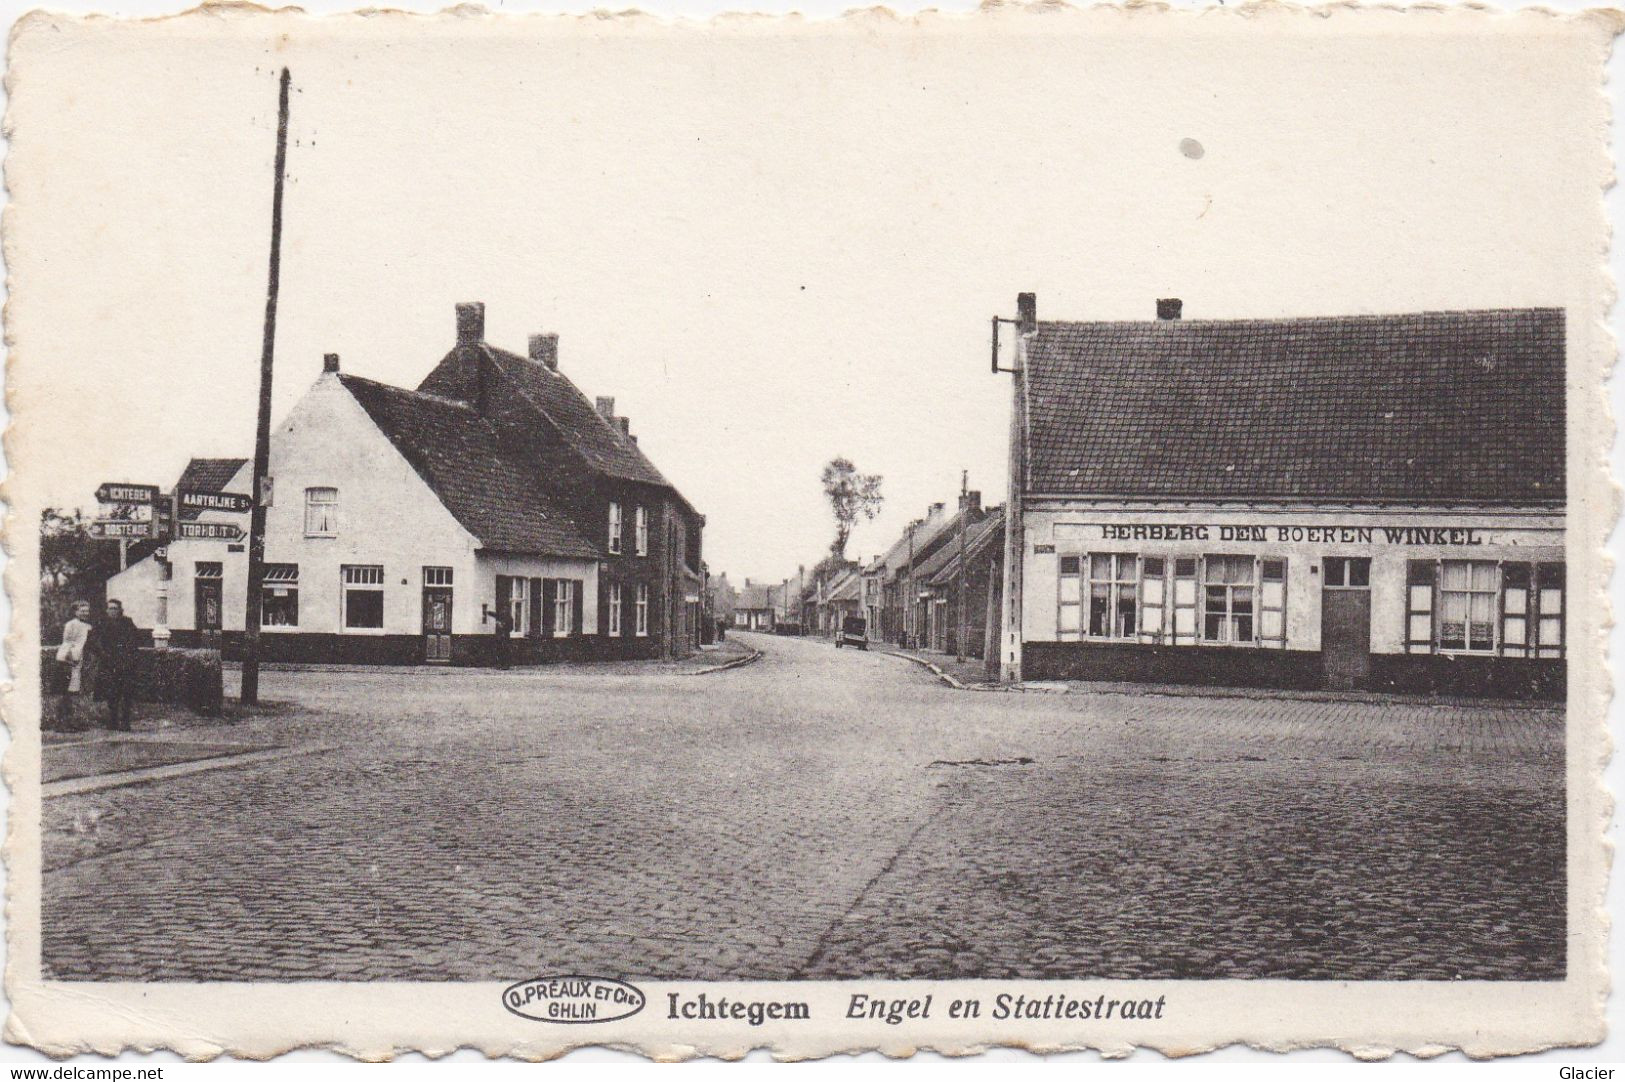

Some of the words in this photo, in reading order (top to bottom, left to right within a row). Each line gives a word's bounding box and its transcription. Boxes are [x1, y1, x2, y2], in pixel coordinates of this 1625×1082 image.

[183, 493, 237, 509] AARTRIJKE
[1101, 524, 1209, 542] HERBERG
[1219, 525, 1268, 542] DEN
[1277, 526, 1373, 543] BOEREN
[1384, 527, 1483, 545] WINKEL
[548, 1002, 597, 1018] GHLIN
